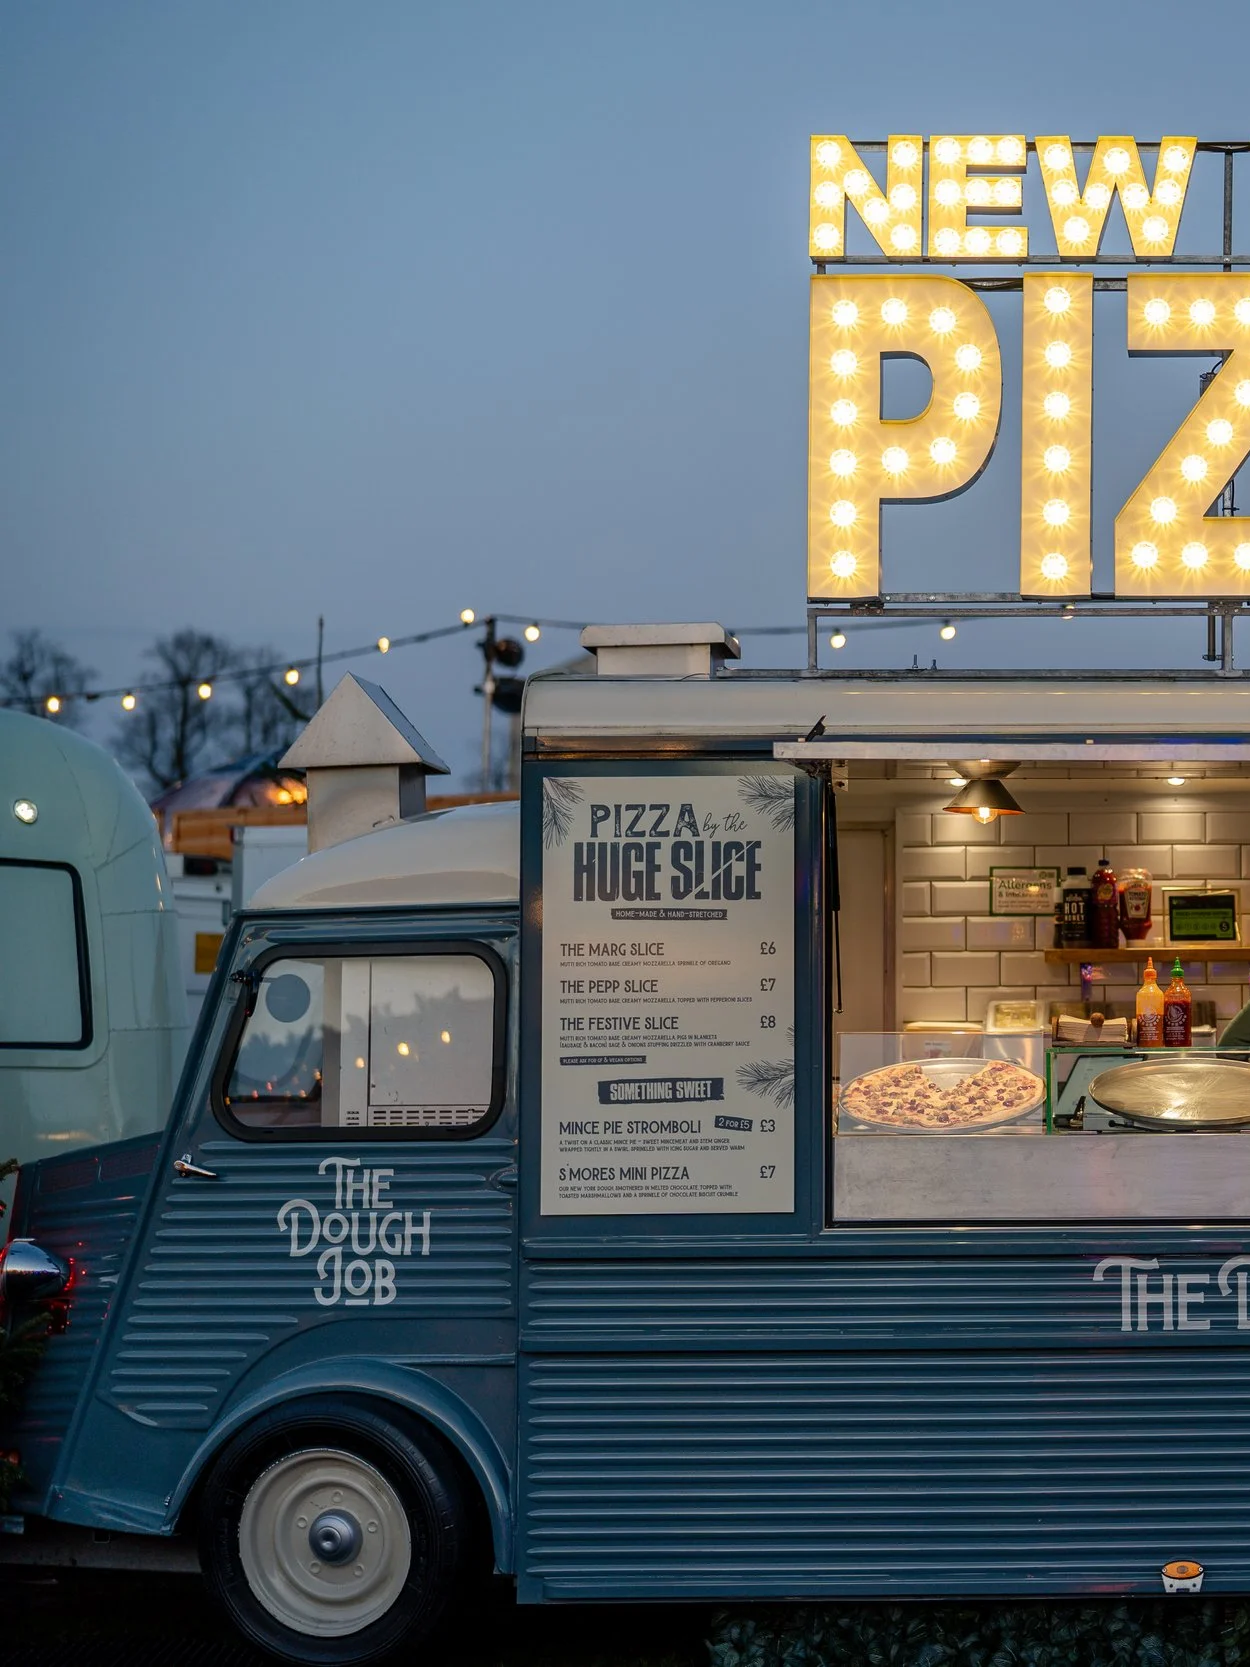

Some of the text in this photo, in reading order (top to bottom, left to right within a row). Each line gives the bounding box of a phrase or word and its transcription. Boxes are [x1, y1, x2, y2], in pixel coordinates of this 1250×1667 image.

[809, 134, 1198, 261] NEW
[590, 803, 748, 838] PIZZA by the
[573, 840, 762, 901] HUGE SLICE
[615, 909, 724, 919] HOME-MADE & HAND-STRETCHED
[1064, 902, 1085, 914] HOT
[560, 942, 664, 956] THE MARG SLICE
[760, 941, 776, 955] £6
[560, 979, 659, 993] THE PEPP SLICE
[760, 978, 776, 991] £7
[560, 1016, 679, 1031] THE FESTIVE SLICE
[760, 1015, 776, 1028] £8
[609, 1080, 713, 1101] SOMETHING SWEET
[559, 1120, 701, 1135] MINCE PIE STROMBOLI
[718, 1117, 750, 1129] 2 FOR £5
[760, 1119, 775, 1132] £3
[620, 1166, 647, 1180] MINI
[651, 1166, 690, 1180] PIZZA
[760, 1165, 776, 1179] £7
[318, 1156, 394, 1209] THE
[277, 1198, 431, 1257] DOUGH
[313, 1246, 397, 1306] JOB
[1092, 1256, 1211, 1331] THE
